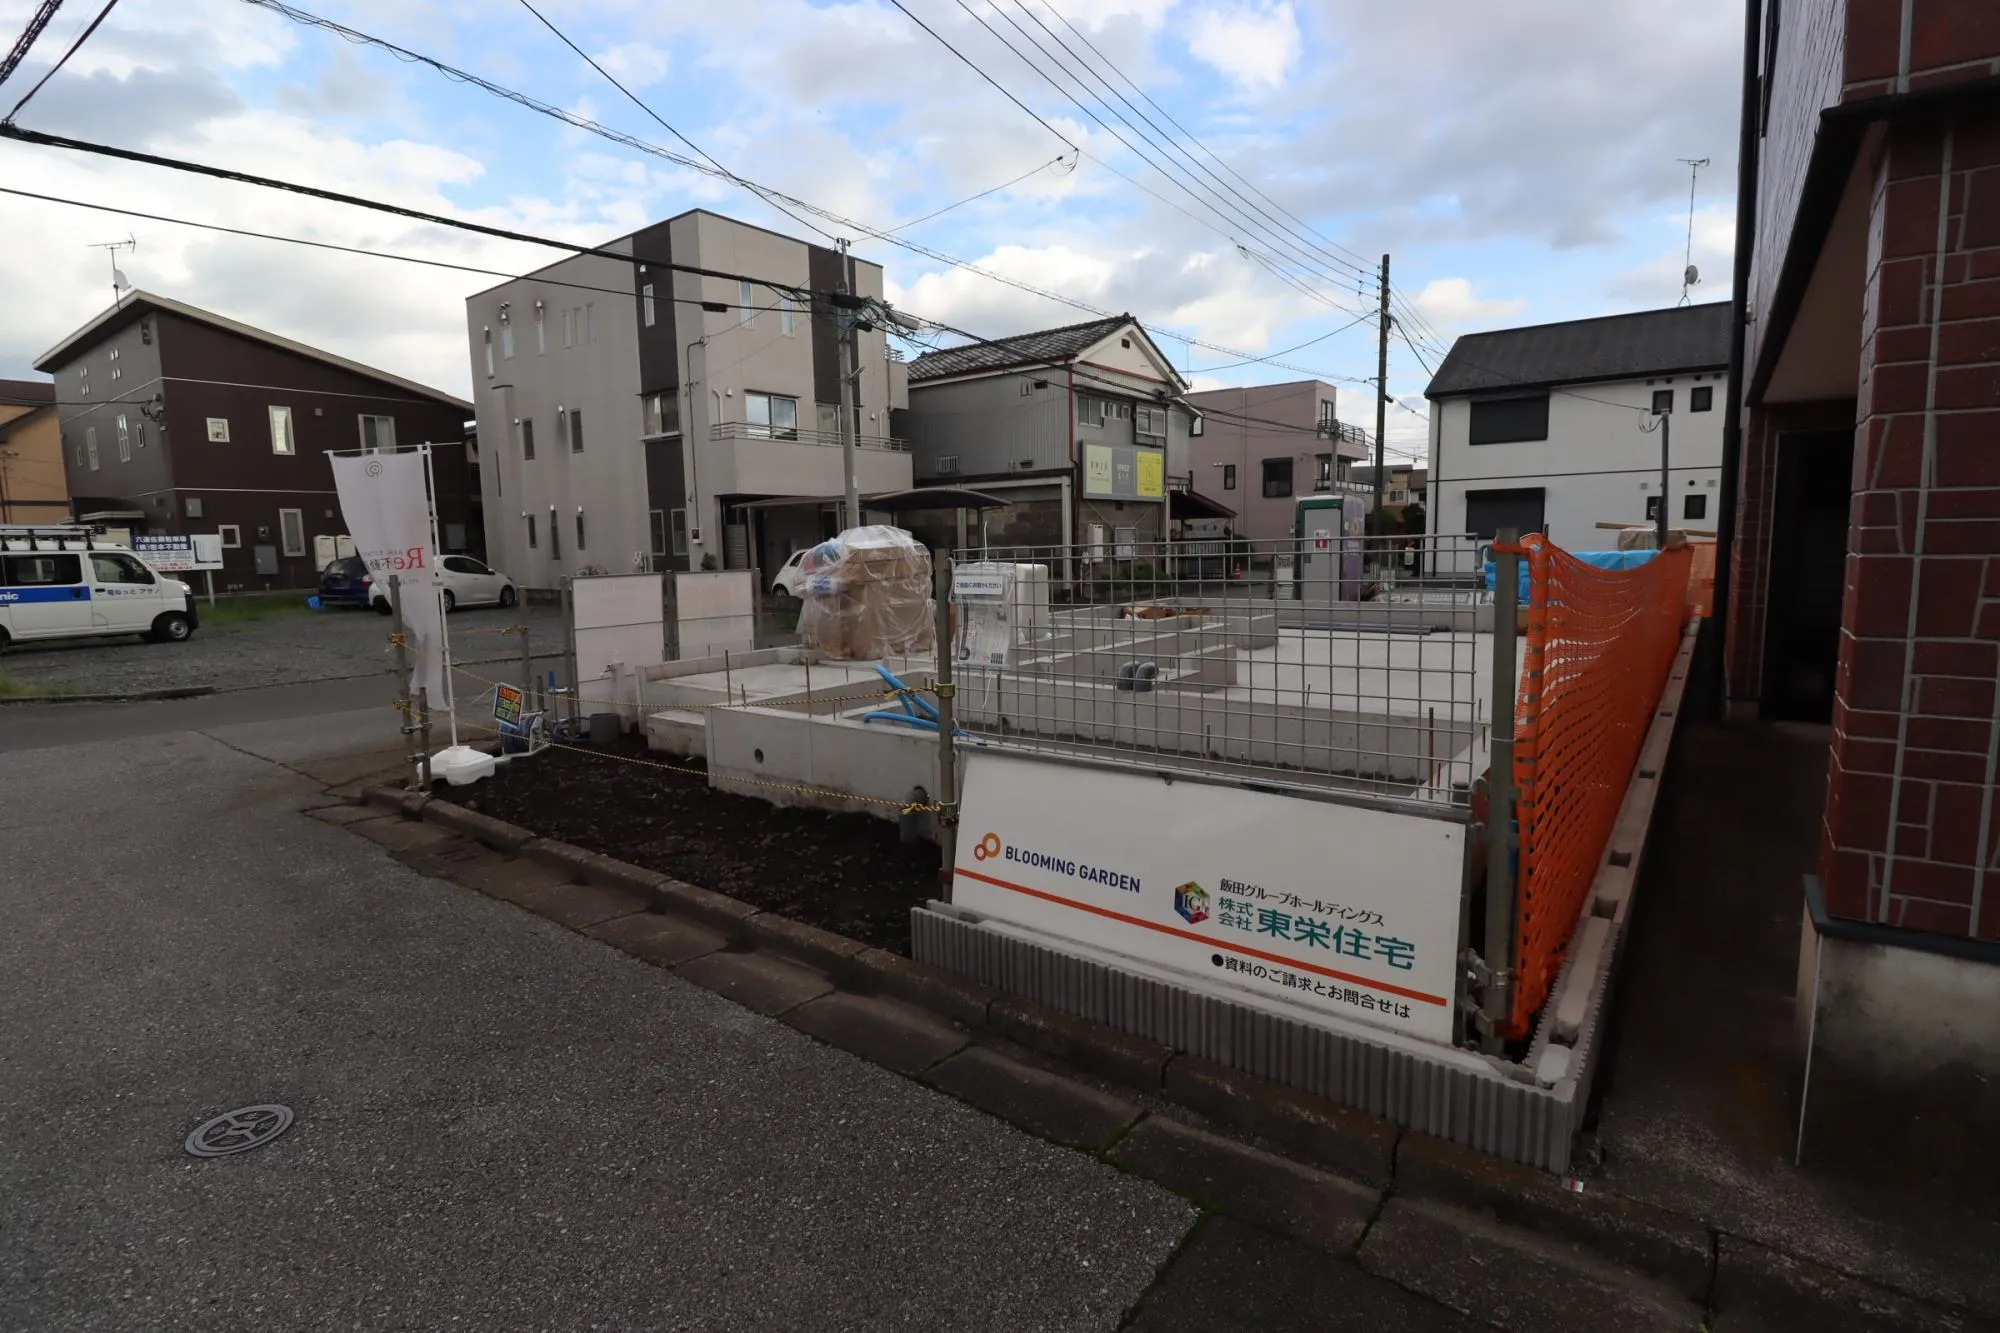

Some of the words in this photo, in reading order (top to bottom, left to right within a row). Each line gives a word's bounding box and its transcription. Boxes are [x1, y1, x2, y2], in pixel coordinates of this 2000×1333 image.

[1005, 846, 1076, 876] BLOOMING
[1079, 865, 1141, 894] GARDEN
[1220, 878, 1386, 927] 飯田グループホールディングス
[1256, 907, 1416, 971] 東栄住宅
[1224, 955, 1411, 1019] 資料のご請求とお問合せは
